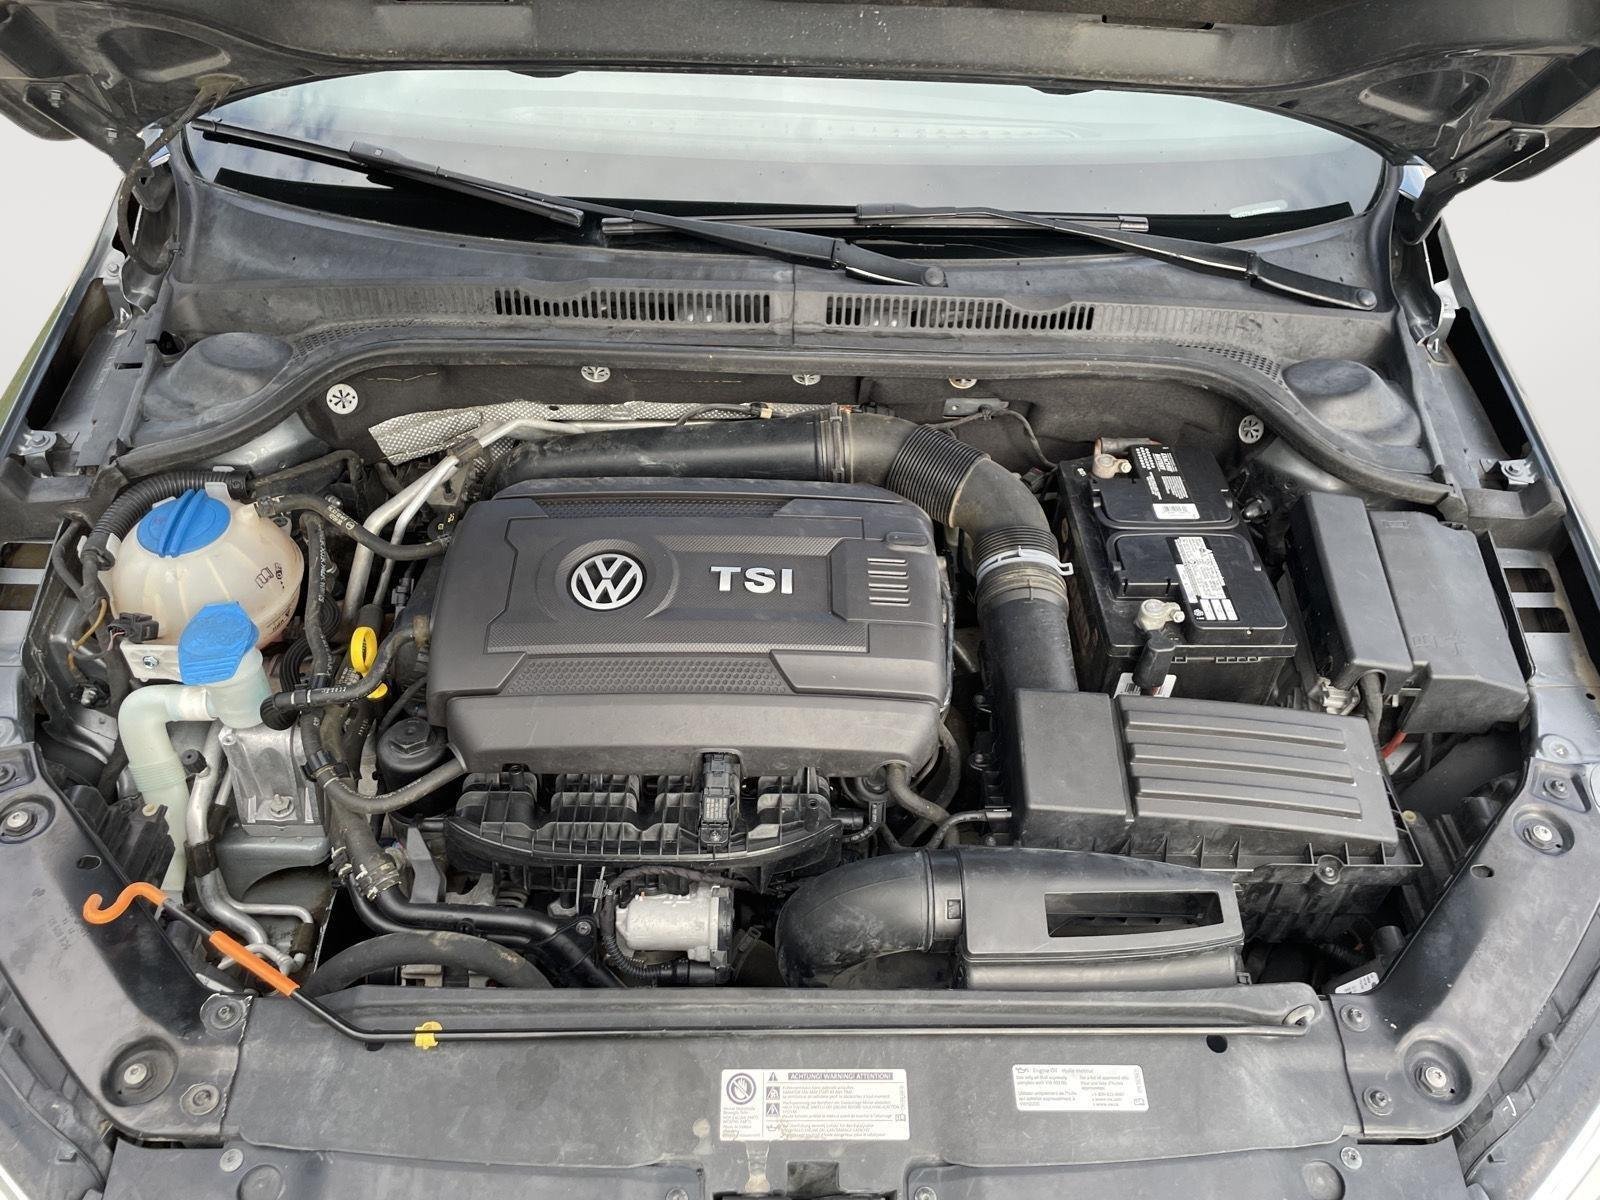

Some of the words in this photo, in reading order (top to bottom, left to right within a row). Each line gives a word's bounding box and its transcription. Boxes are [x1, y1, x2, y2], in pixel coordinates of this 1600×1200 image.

[570, 553, 643, 610] VW
[710, 566, 793, 595] TSI
[824, 1072, 854, 1080] WARNING!
[856, 1072, 892, 1080] ATTENTION!
